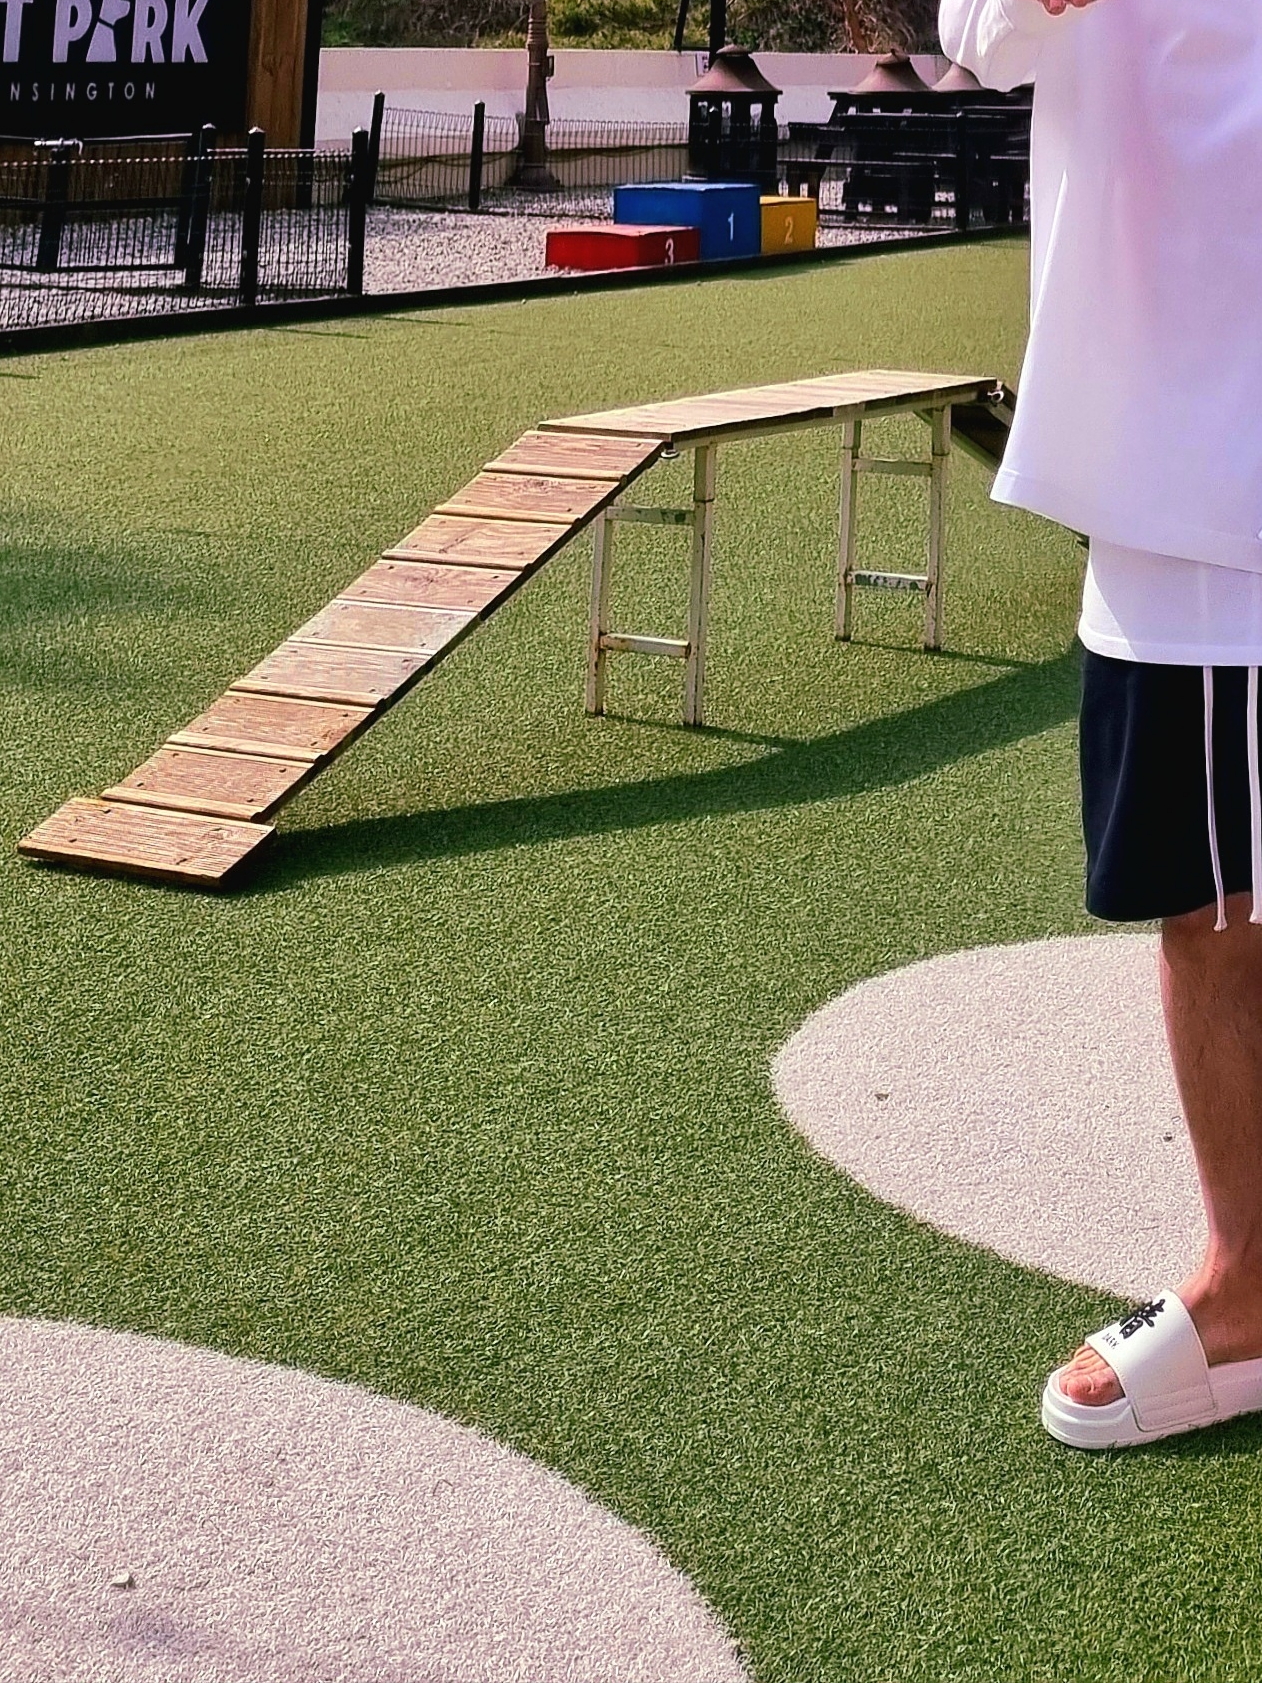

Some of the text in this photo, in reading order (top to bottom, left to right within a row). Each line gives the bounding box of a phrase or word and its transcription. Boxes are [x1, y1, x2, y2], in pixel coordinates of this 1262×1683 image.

[10, 81, 156, 102] NSINGTON
[727, 211, 735, 242] 1
[784, 216, 795, 244] 2
[664, 238, 675, 265] 3
